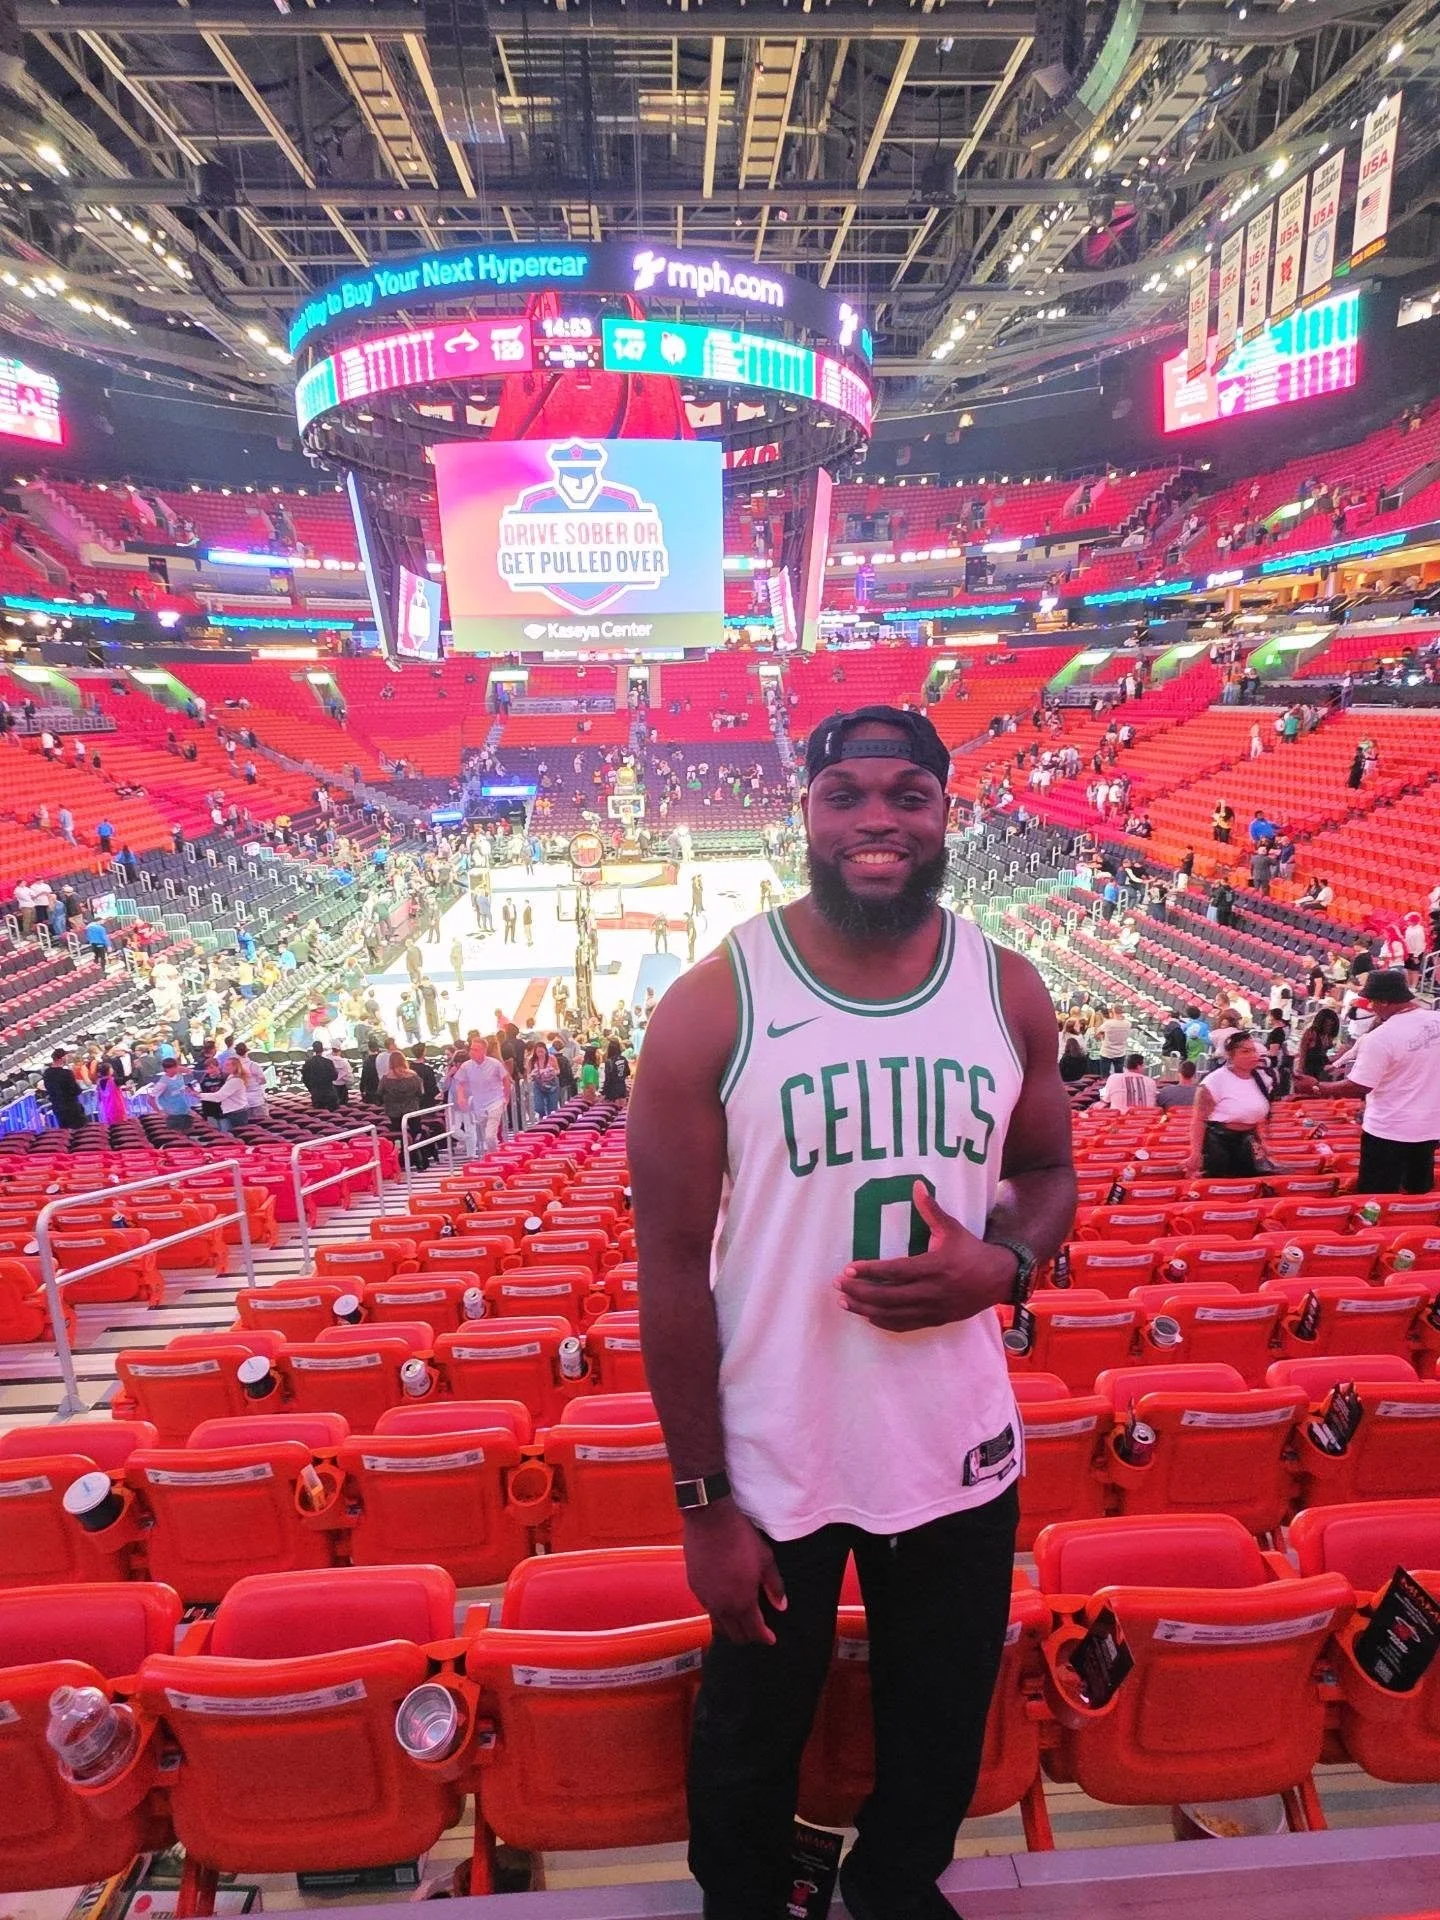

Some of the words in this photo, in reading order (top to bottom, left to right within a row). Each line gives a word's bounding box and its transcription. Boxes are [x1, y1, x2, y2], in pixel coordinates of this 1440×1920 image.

[1362, 150, 1388, 179] USA
[1313, 201, 1334, 227] USA
[1280, 221, 1300, 245] USA
[327, 293, 342, 315] to
[342, 282, 373, 308] Buy
[374, 269, 420, 297] Your
[422, 257, 475, 287] Next
[478, 253, 588, 285] Hypercar
[667, 260, 785, 308] mph.com
[503, 522, 559, 546] DRIVE
[564, 521, 628, 545] SOBER
[633, 521, 660, 545] OR
[501, 551, 536, 575] GET
[540, 550, 612, 574] PULLED
[616, 550, 665, 573] OVER
[547, 622, 600, 641] Kaseya
[601, 621, 653, 638] Center
[780, 1056, 996, 1177] CELTICS
